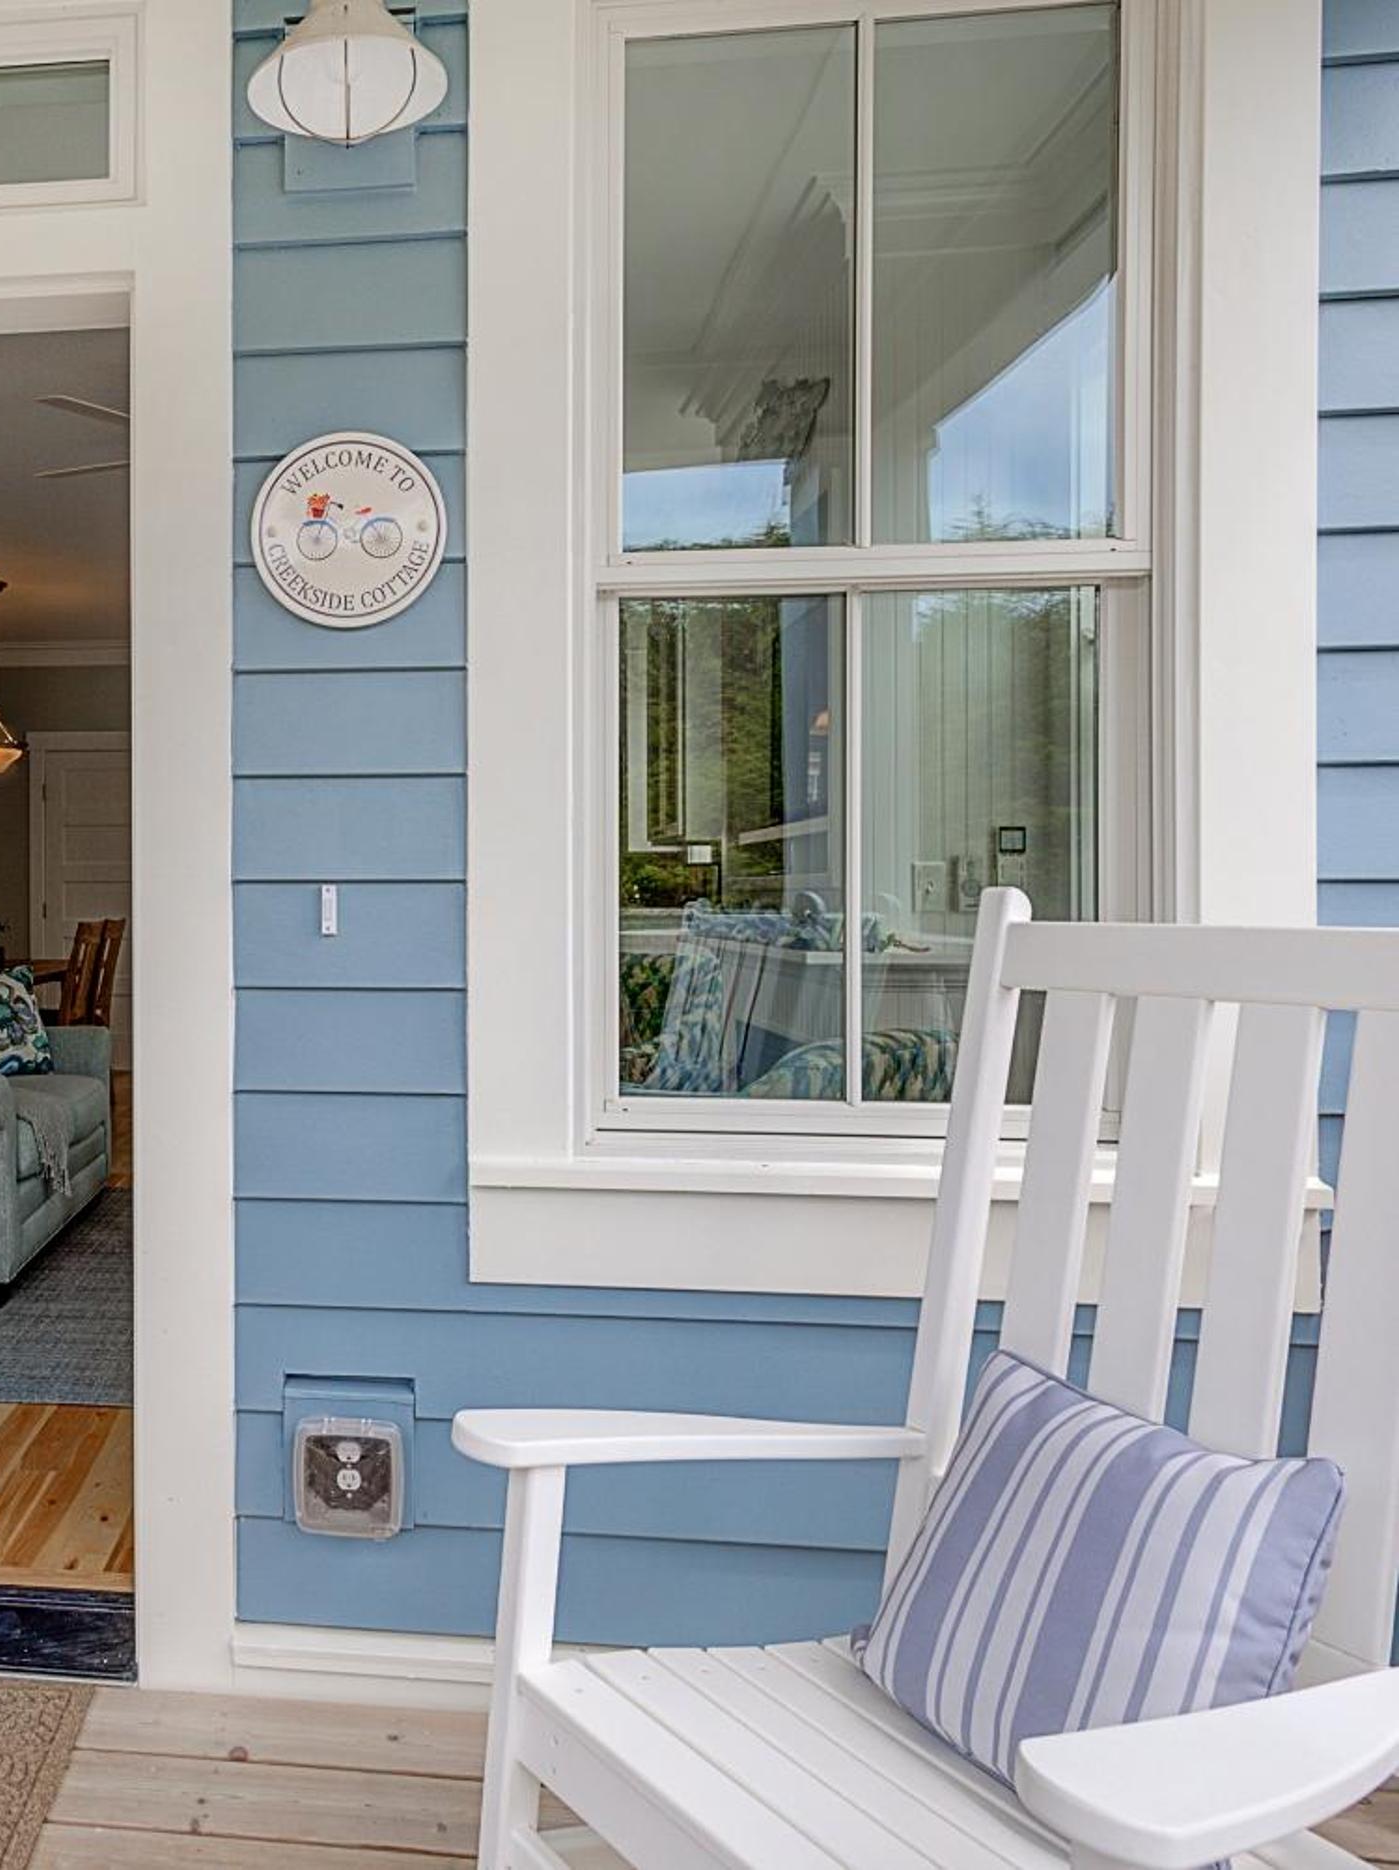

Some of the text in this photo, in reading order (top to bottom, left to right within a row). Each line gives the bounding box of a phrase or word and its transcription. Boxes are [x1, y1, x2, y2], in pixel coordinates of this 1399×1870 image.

[281, 450, 415, 494] WELCOME TO
[268, 541, 429, 611] CREEKSIDE COTTAGE
